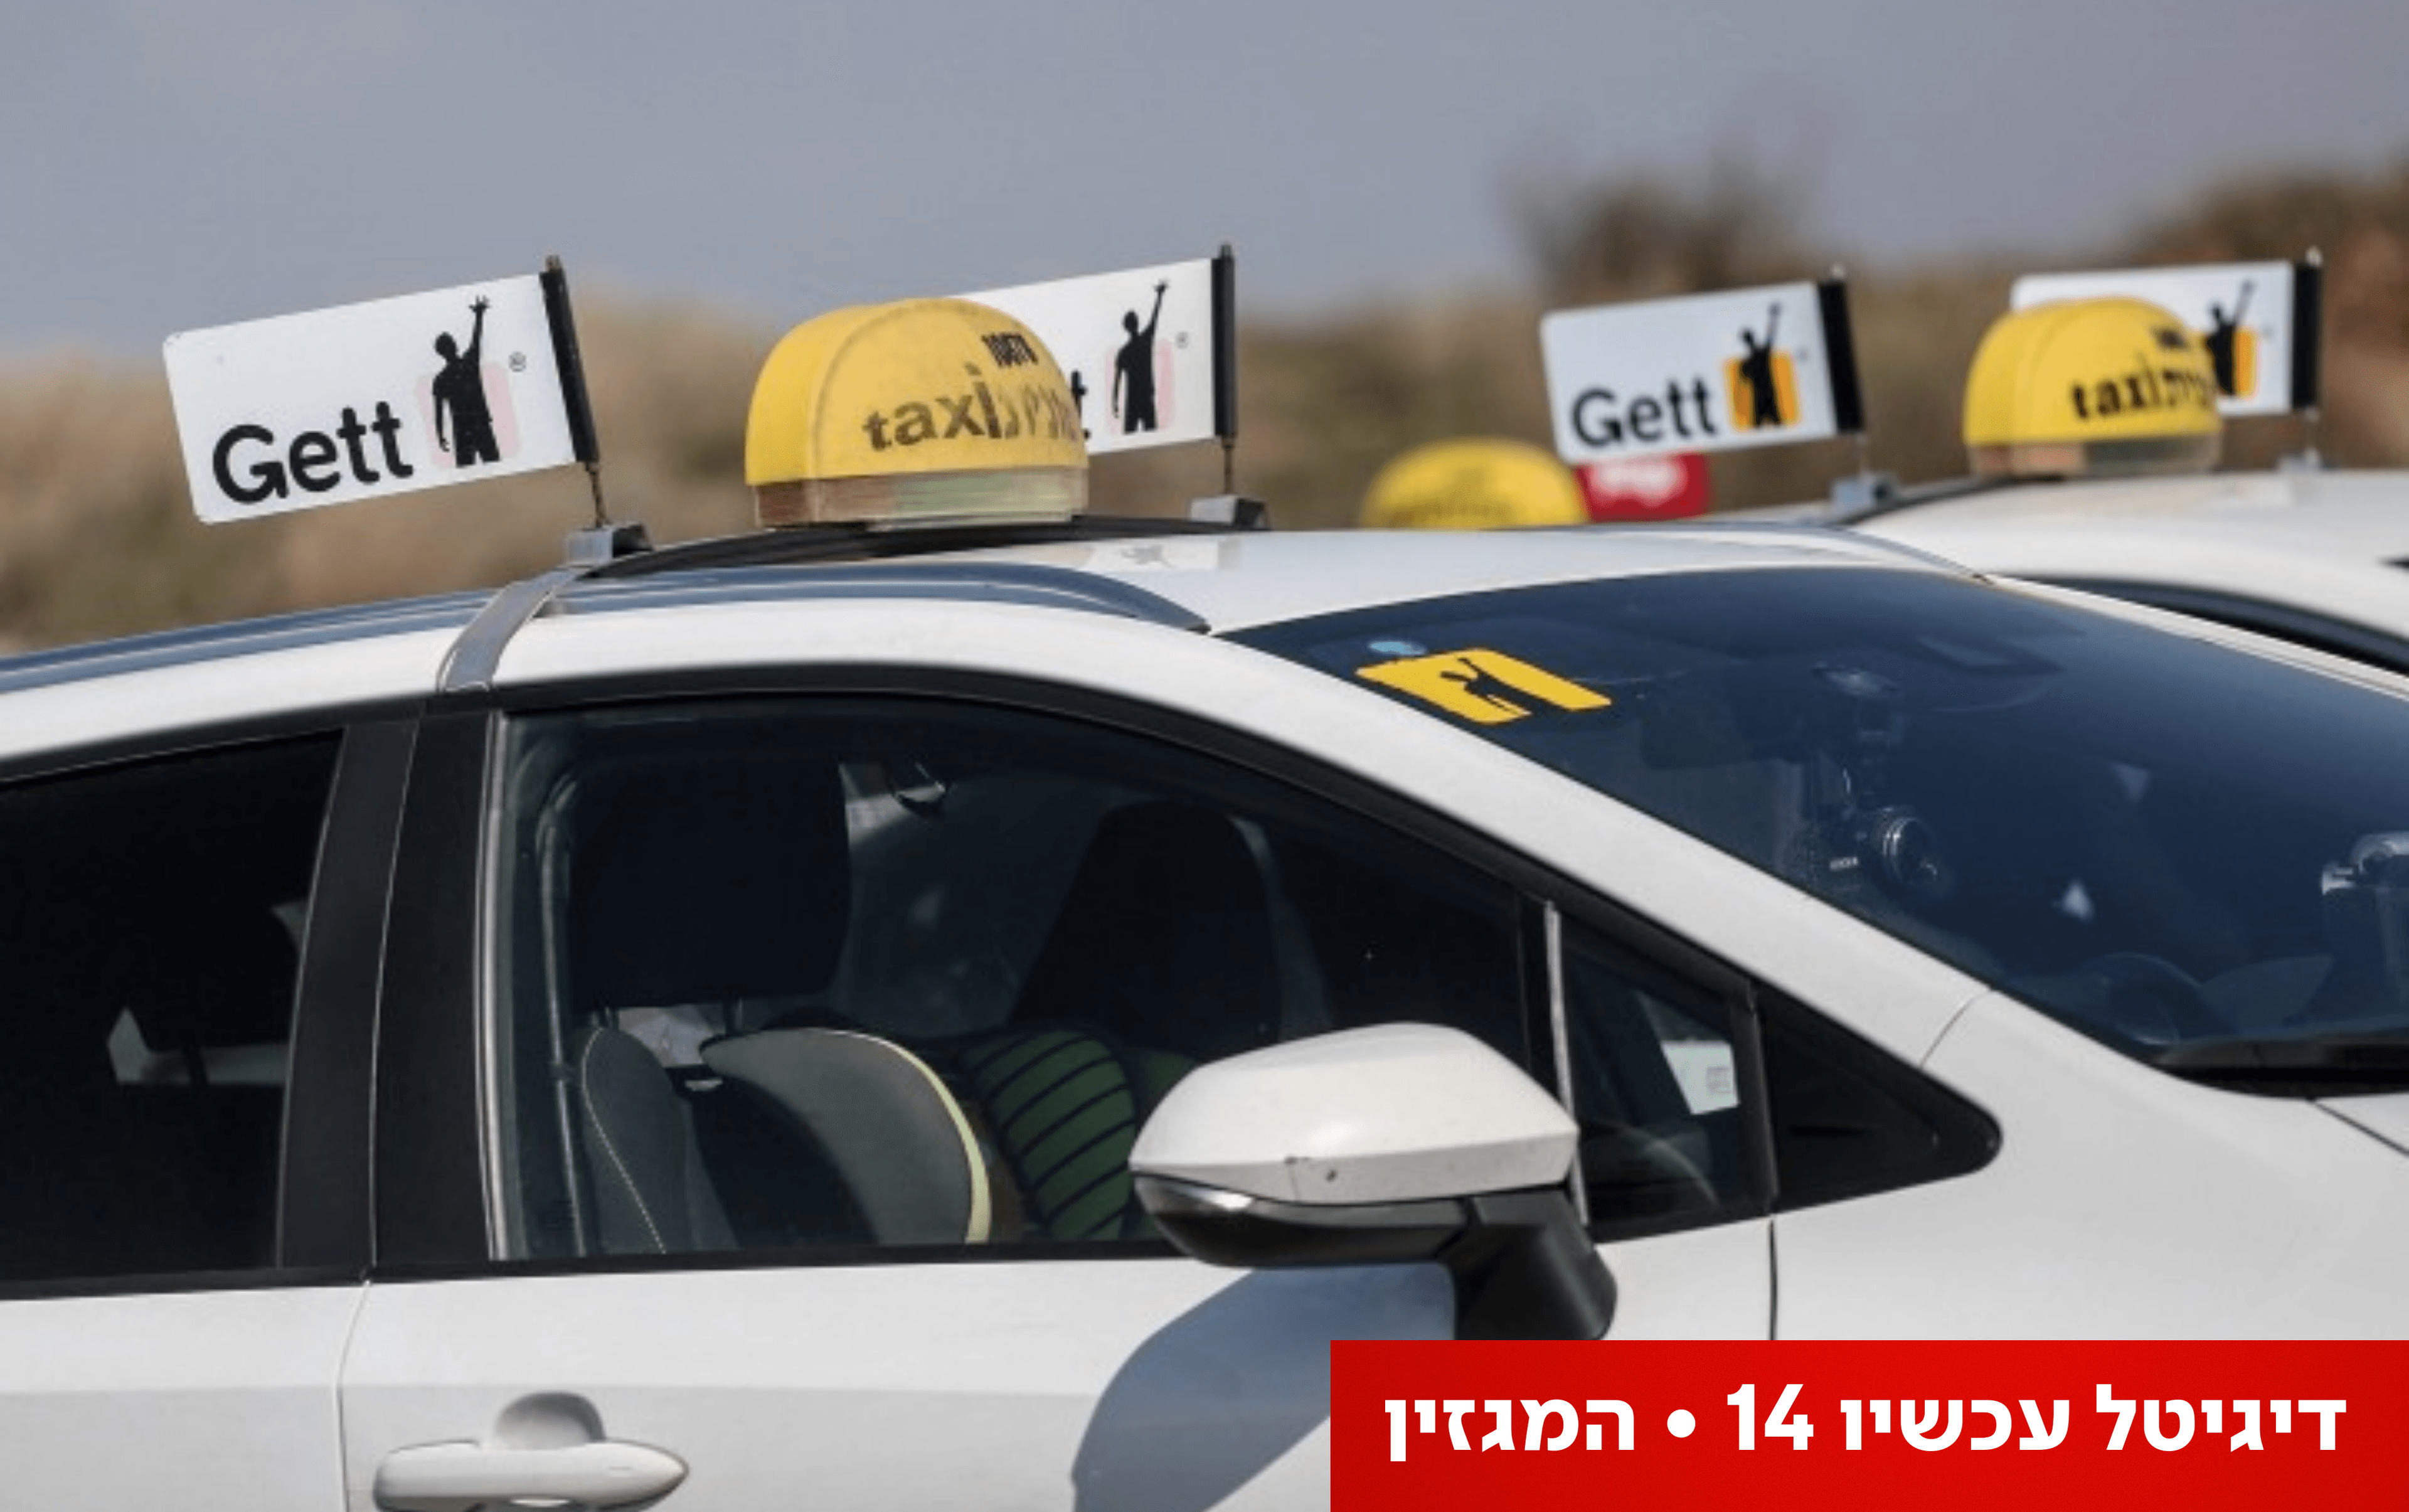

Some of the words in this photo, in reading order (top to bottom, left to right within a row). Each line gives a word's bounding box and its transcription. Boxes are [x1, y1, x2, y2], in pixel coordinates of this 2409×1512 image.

[862, 363, 1003, 452] taxi
[1570, 379, 1717, 449] Gett
[211, 400, 415, 505] Gett
